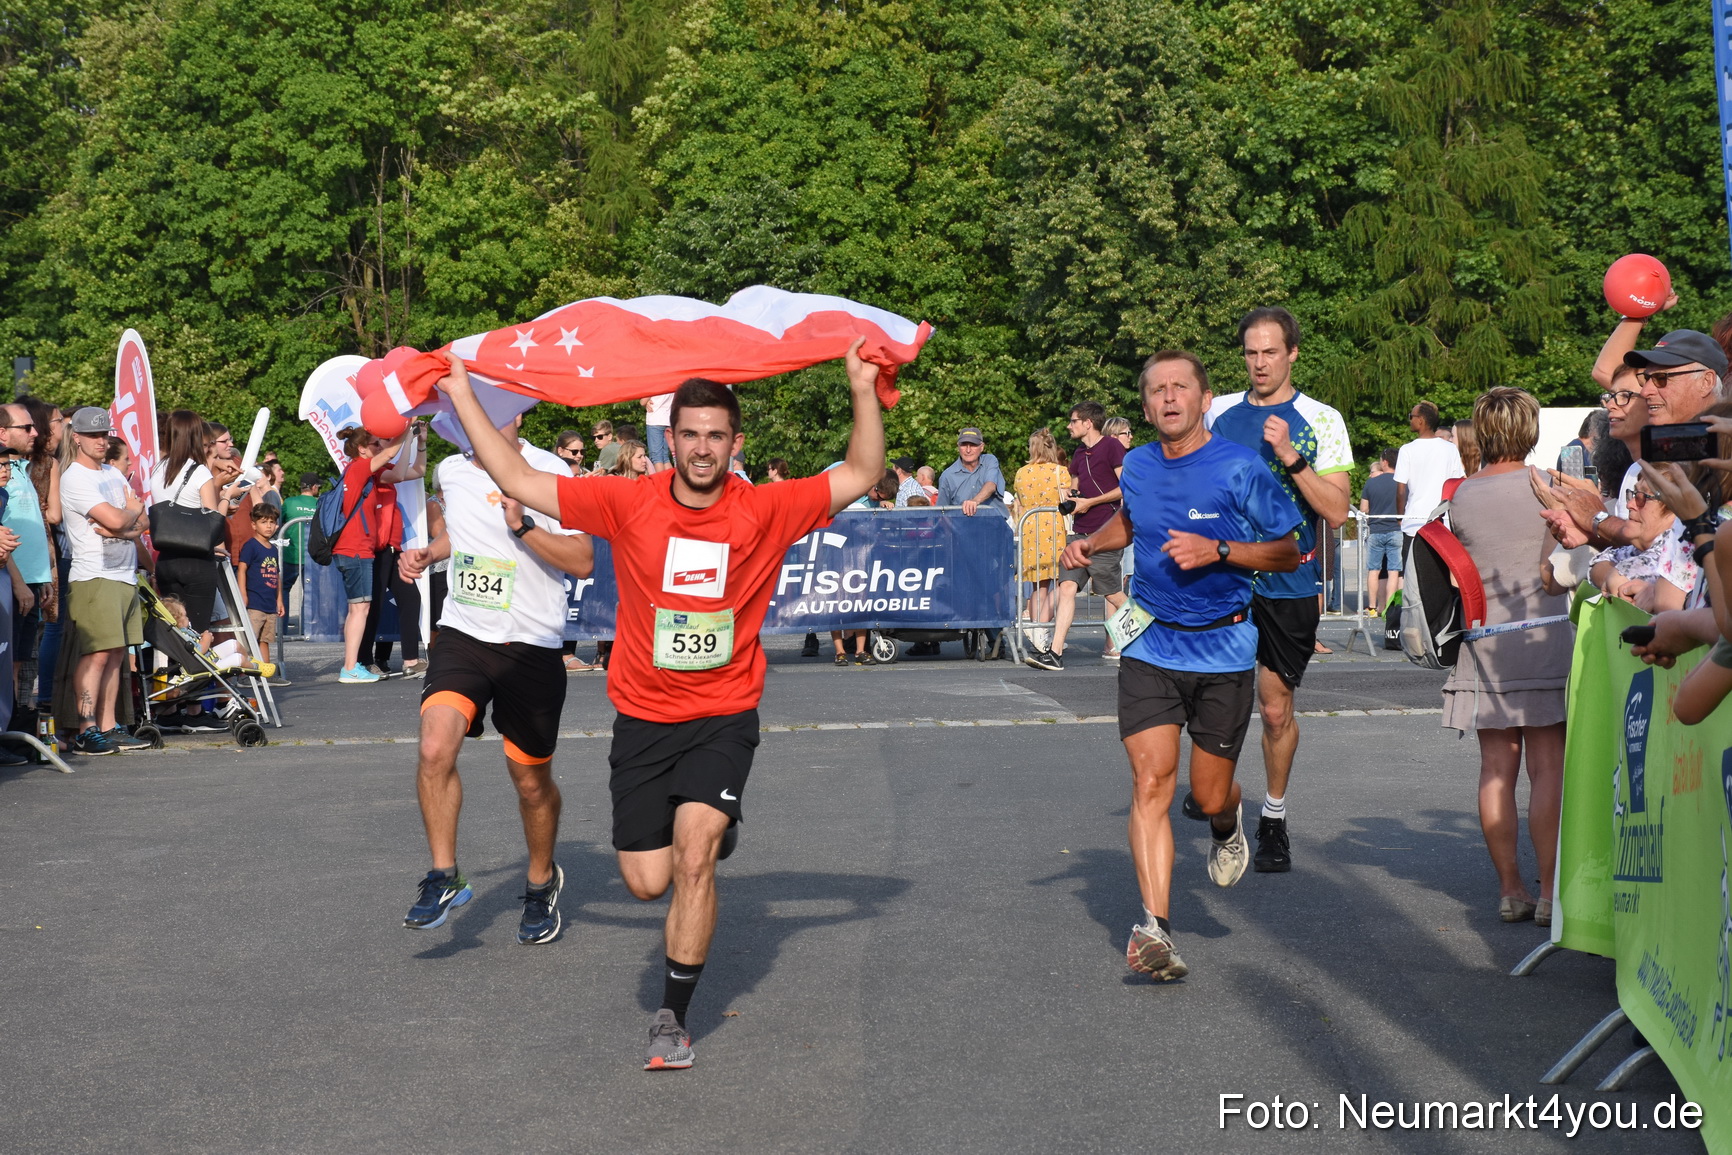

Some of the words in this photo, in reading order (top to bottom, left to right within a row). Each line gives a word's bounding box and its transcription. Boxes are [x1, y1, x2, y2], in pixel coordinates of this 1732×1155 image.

[458, 571, 503, 595] 1334
[684, 572, 706, 582] DEHN
[777, 560, 944, 595] Fischer
[793, 597, 930, 614] AUTOMOBILE
[672, 633, 717, 653] 539
[1627, 714, 1647, 738] Fischer
